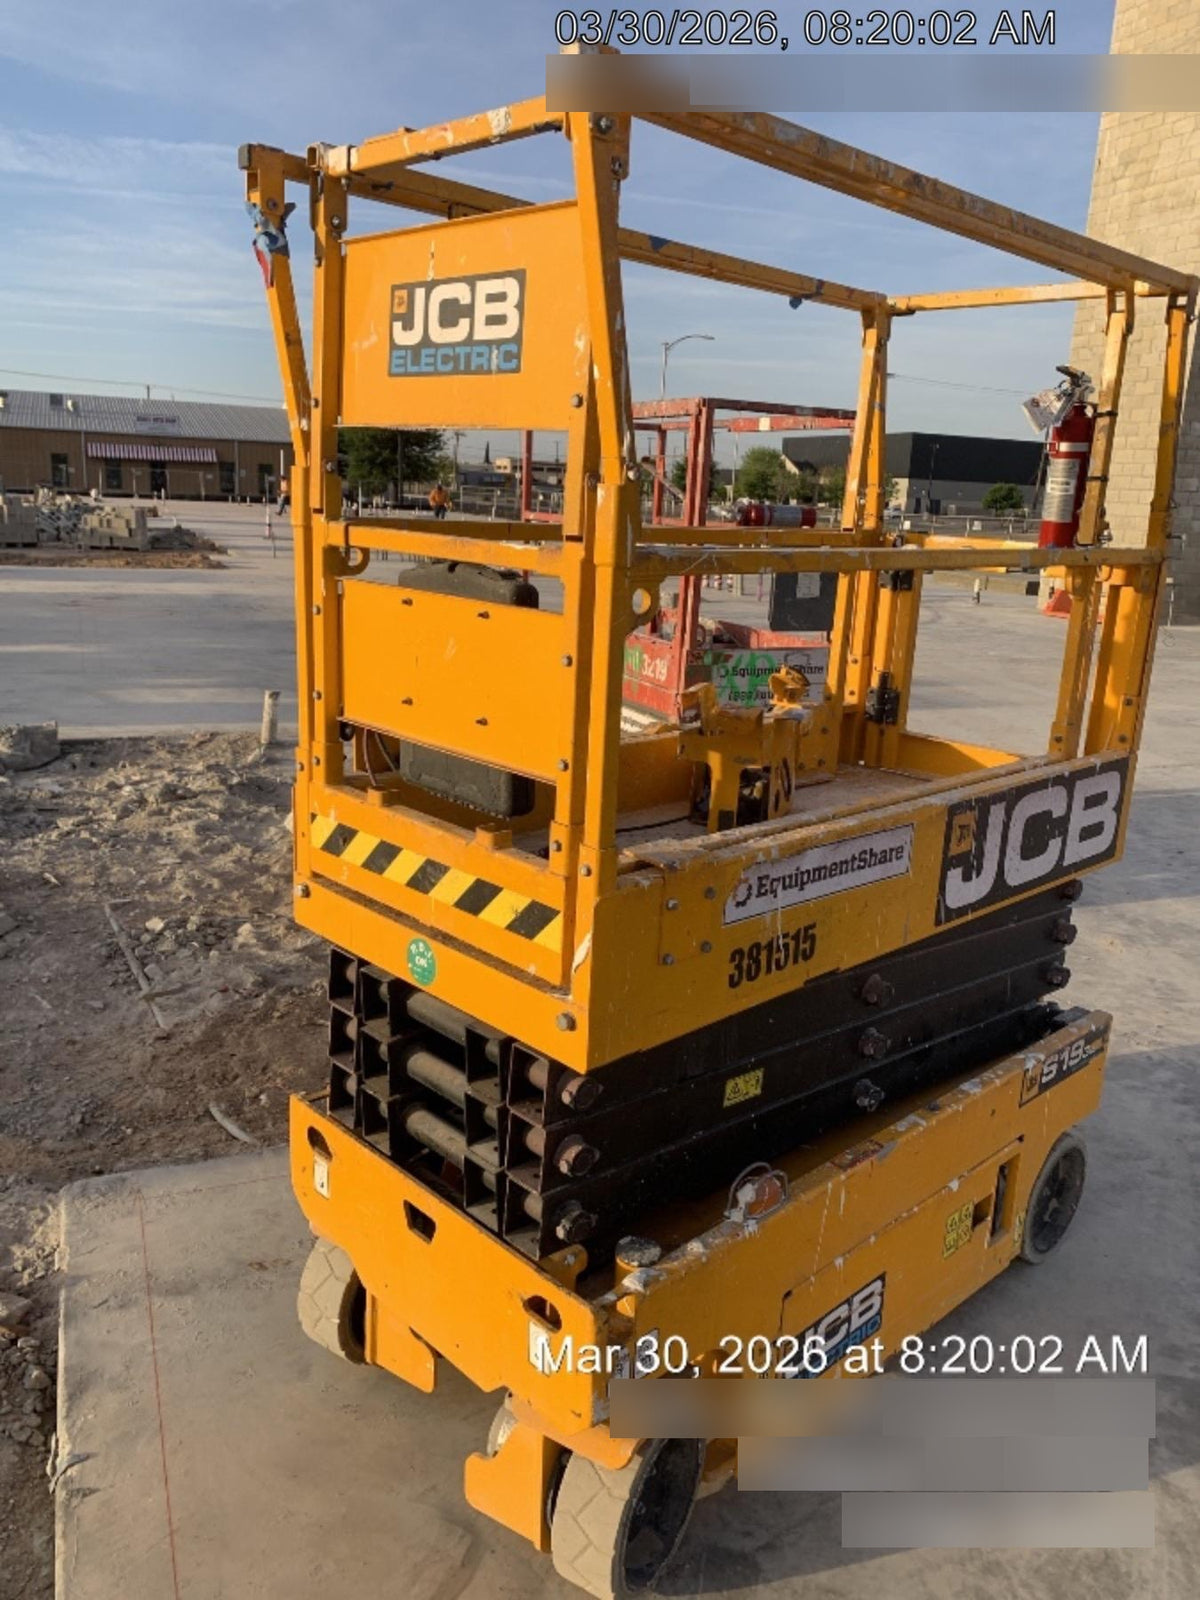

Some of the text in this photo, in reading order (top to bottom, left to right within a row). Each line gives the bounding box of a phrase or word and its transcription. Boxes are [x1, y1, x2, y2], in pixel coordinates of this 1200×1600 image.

[392, 277, 520, 346] JCB
[390, 343, 519, 374] ELECTRIC
[755, 845, 904, 899] EquipmentShare
[945, 771, 1121, 909] JCB
[728, 922, 817, 989] 381515
[784, 1279, 883, 1378] JCB
